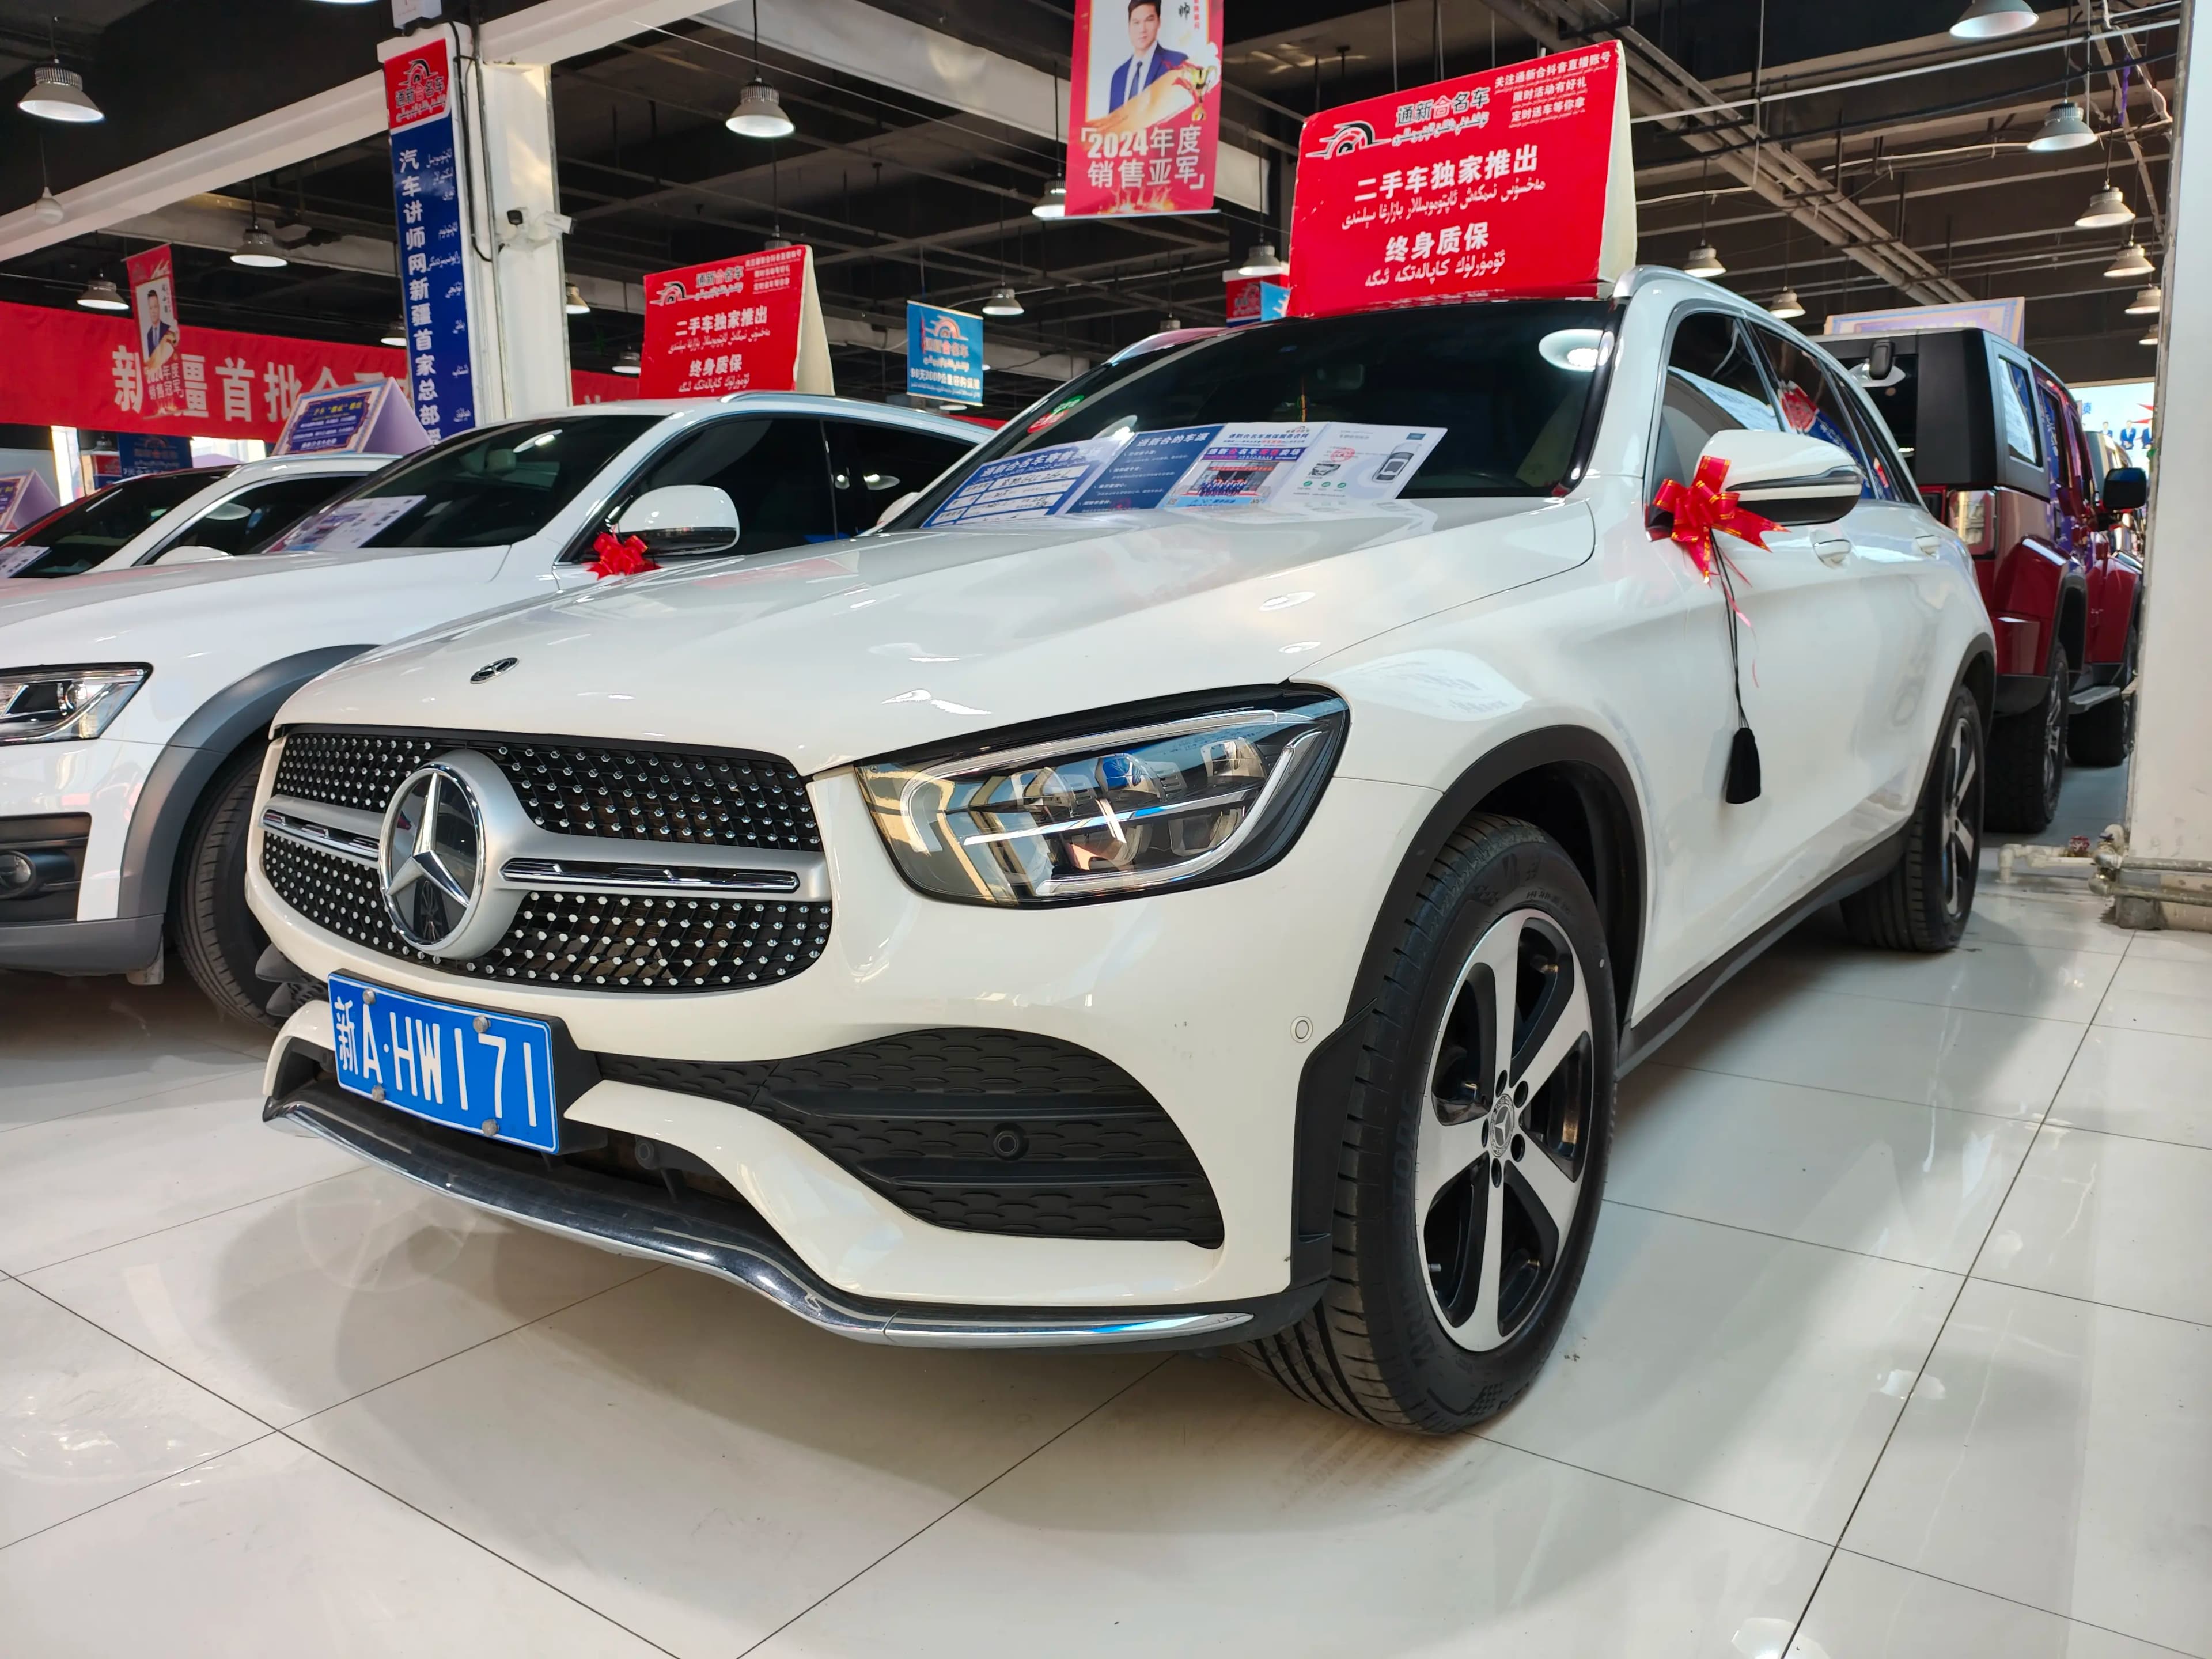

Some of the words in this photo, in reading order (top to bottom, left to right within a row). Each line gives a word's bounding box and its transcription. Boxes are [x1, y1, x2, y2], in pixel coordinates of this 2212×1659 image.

[1495, 51, 1611, 88] 关注通新合抖音直播账号
[396, 76, 445, 109] 通新合名车
[1513, 77, 1587, 103] 限时活动有好礼
[1395, 87, 1491, 128] 通新合名车
[1510, 96, 1586, 123] 定时送车等你拿
[1354, 144, 1539, 202] 二手车独家推出
[1385, 222, 1489, 263] 终身质保
[675, 305, 767, 336] 二手车独家推出
[688, 354, 742, 377] 终身质保
